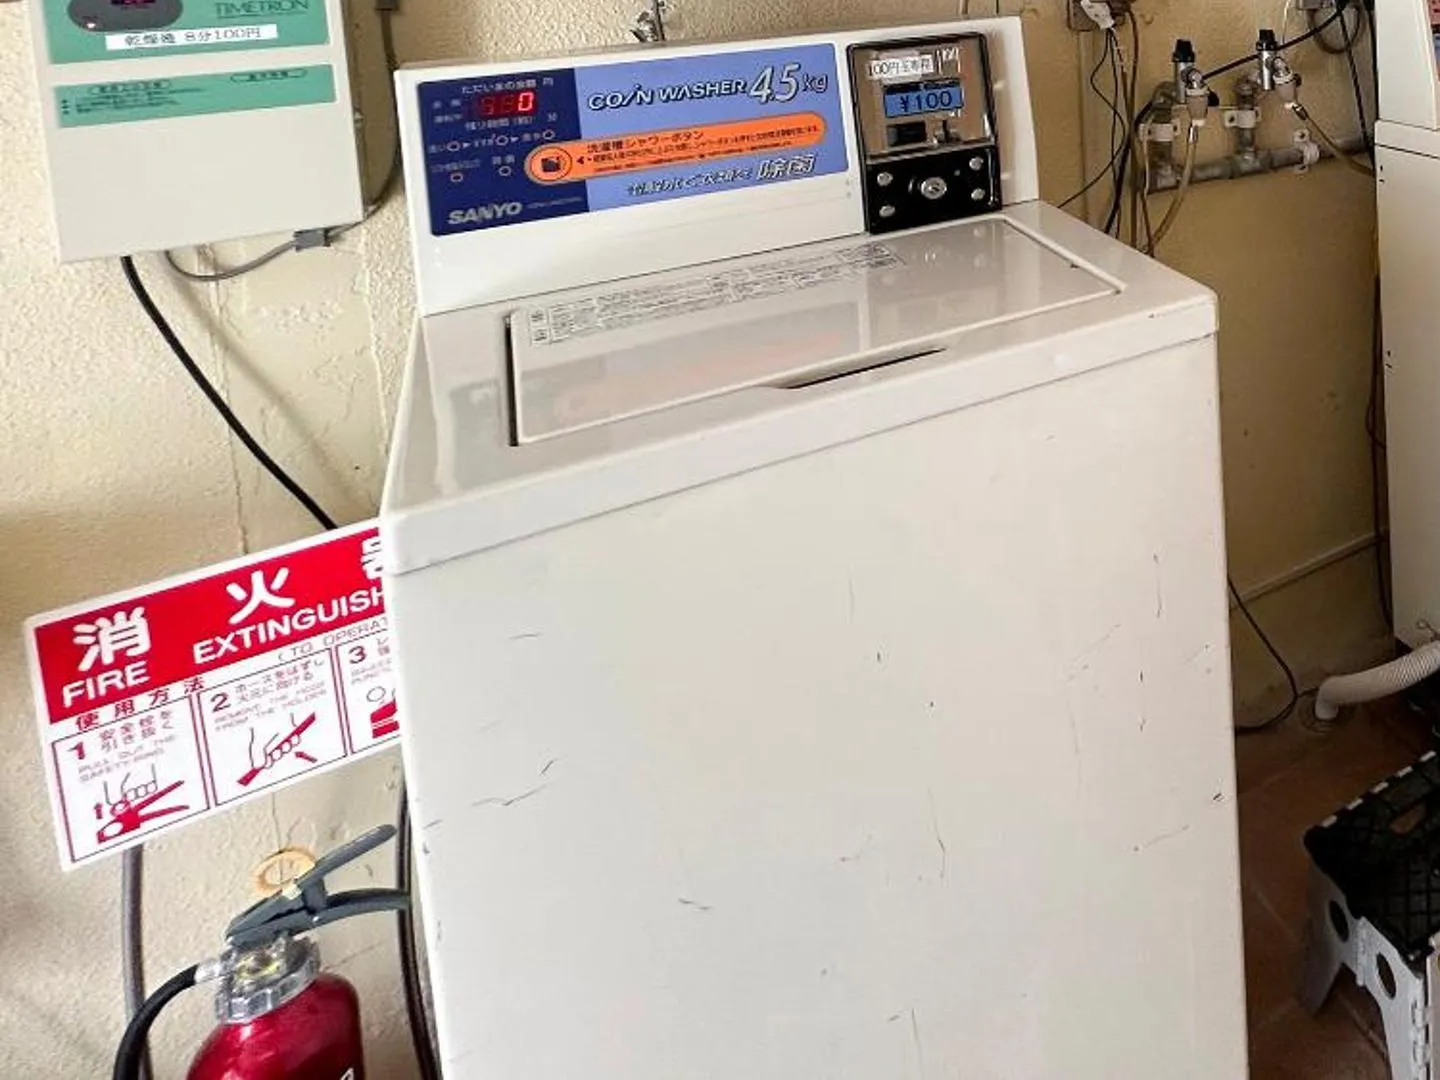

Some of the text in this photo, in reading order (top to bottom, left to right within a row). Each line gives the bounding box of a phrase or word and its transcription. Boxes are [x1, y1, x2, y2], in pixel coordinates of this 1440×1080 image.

[588, 84, 653, 111] COIN
[658, 79, 747, 103] WASHER
[802, 73, 829, 93] kg
[900, 91, 952, 112] ¥100
[448, 201, 522, 225] SANYO
[348, 645, 367, 664] 3
[62, 660, 150, 708] FIRE
[75, 676, 205, 732] 使用方法
[211, 692, 231, 713] 2
[67, 741, 86, 760] 1
